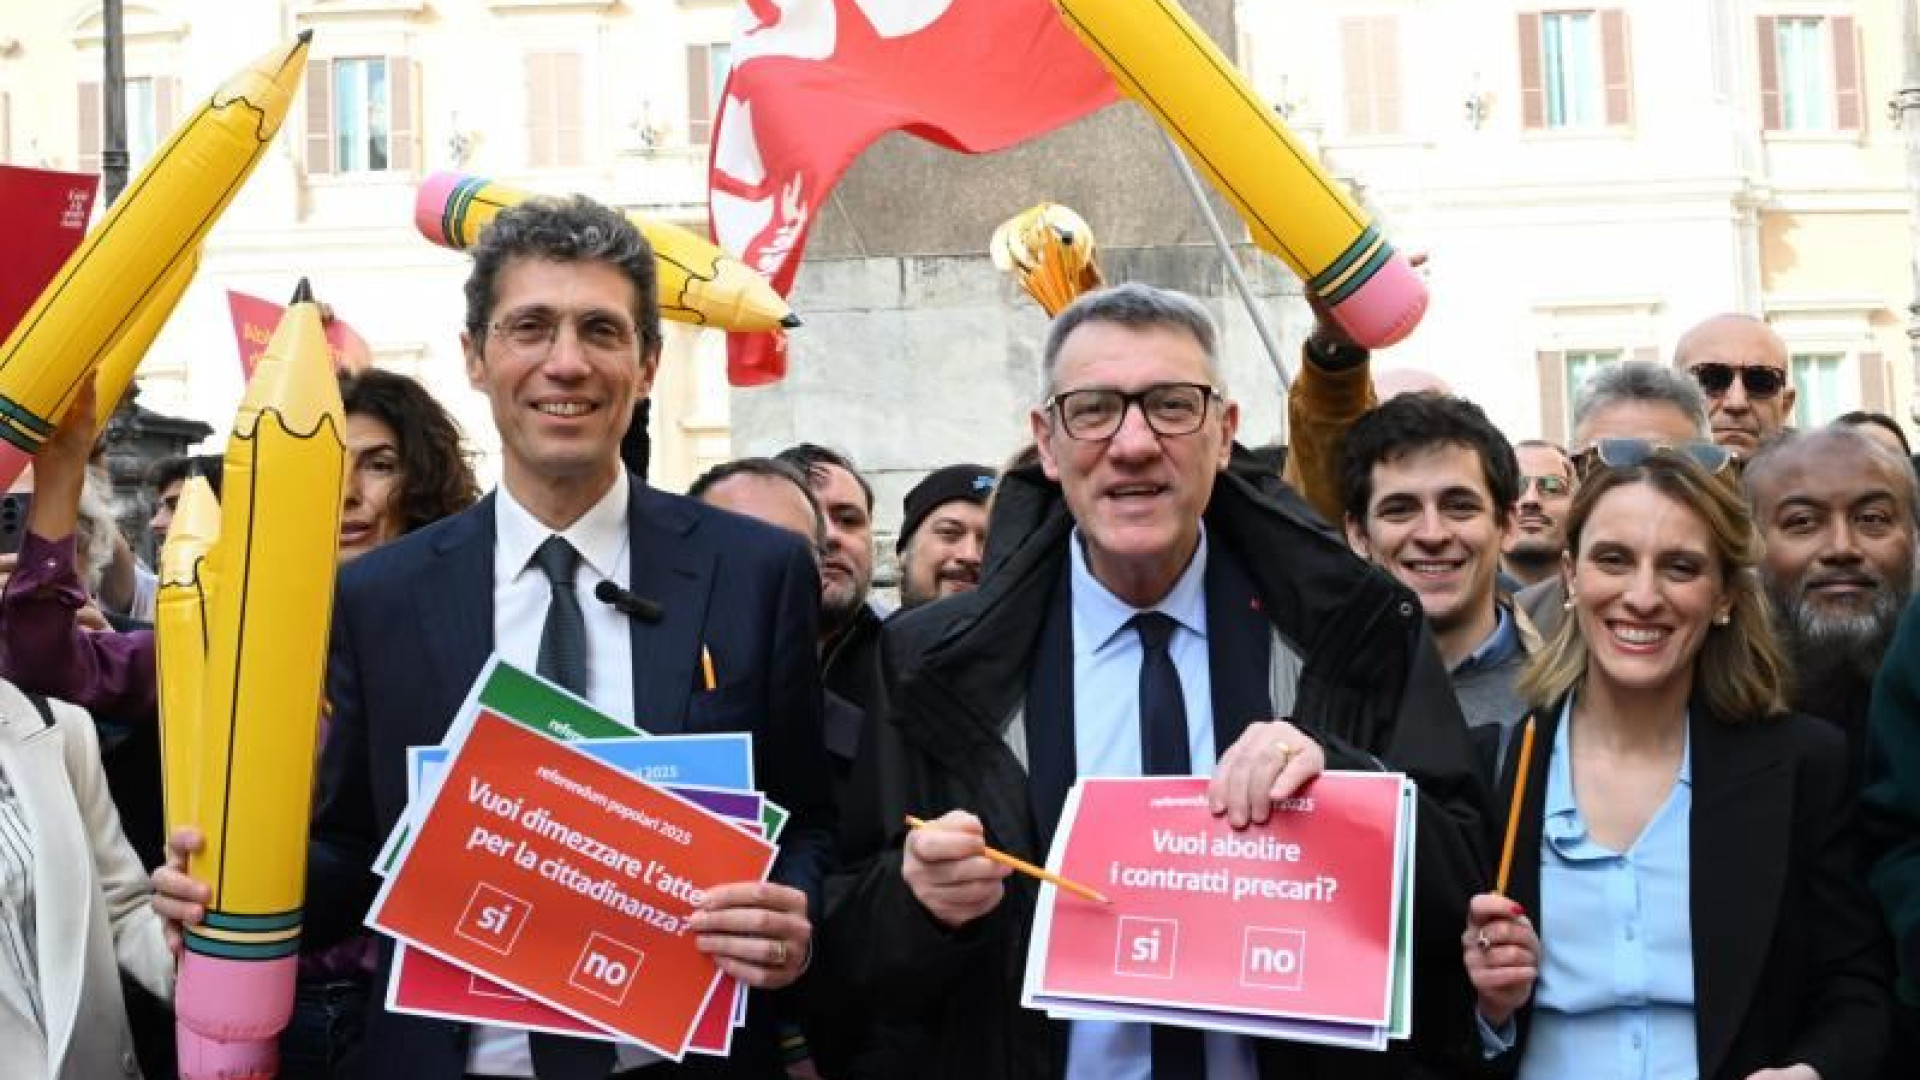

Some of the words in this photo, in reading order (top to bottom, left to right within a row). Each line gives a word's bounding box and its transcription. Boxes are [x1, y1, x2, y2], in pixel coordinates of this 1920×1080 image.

[536, 766, 609, 808] referendum
[604, 801, 658, 831] popolari
[657, 820, 693, 845] 2025
[468, 776, 524, 821] Vuoi
[522, 807, 642, 878] dimezzare
[643, 860, 702, 907] l'atte
[1152, 829, 1207, 856] Vuoi
[1210, 833, 1301, 862] abolire
[465, 826, 515, 857] per
[513, 841, 538, 870] la
[539, 858, 692, 937] cittadinanza?
[1110, 861, 1119, 885] i
[1121, 867, 1229, 894] contratti
[1233, 875, 1338, 902] precari?
[583, 951, 628, 987] no
[1251, 945, 1296, 974] no
